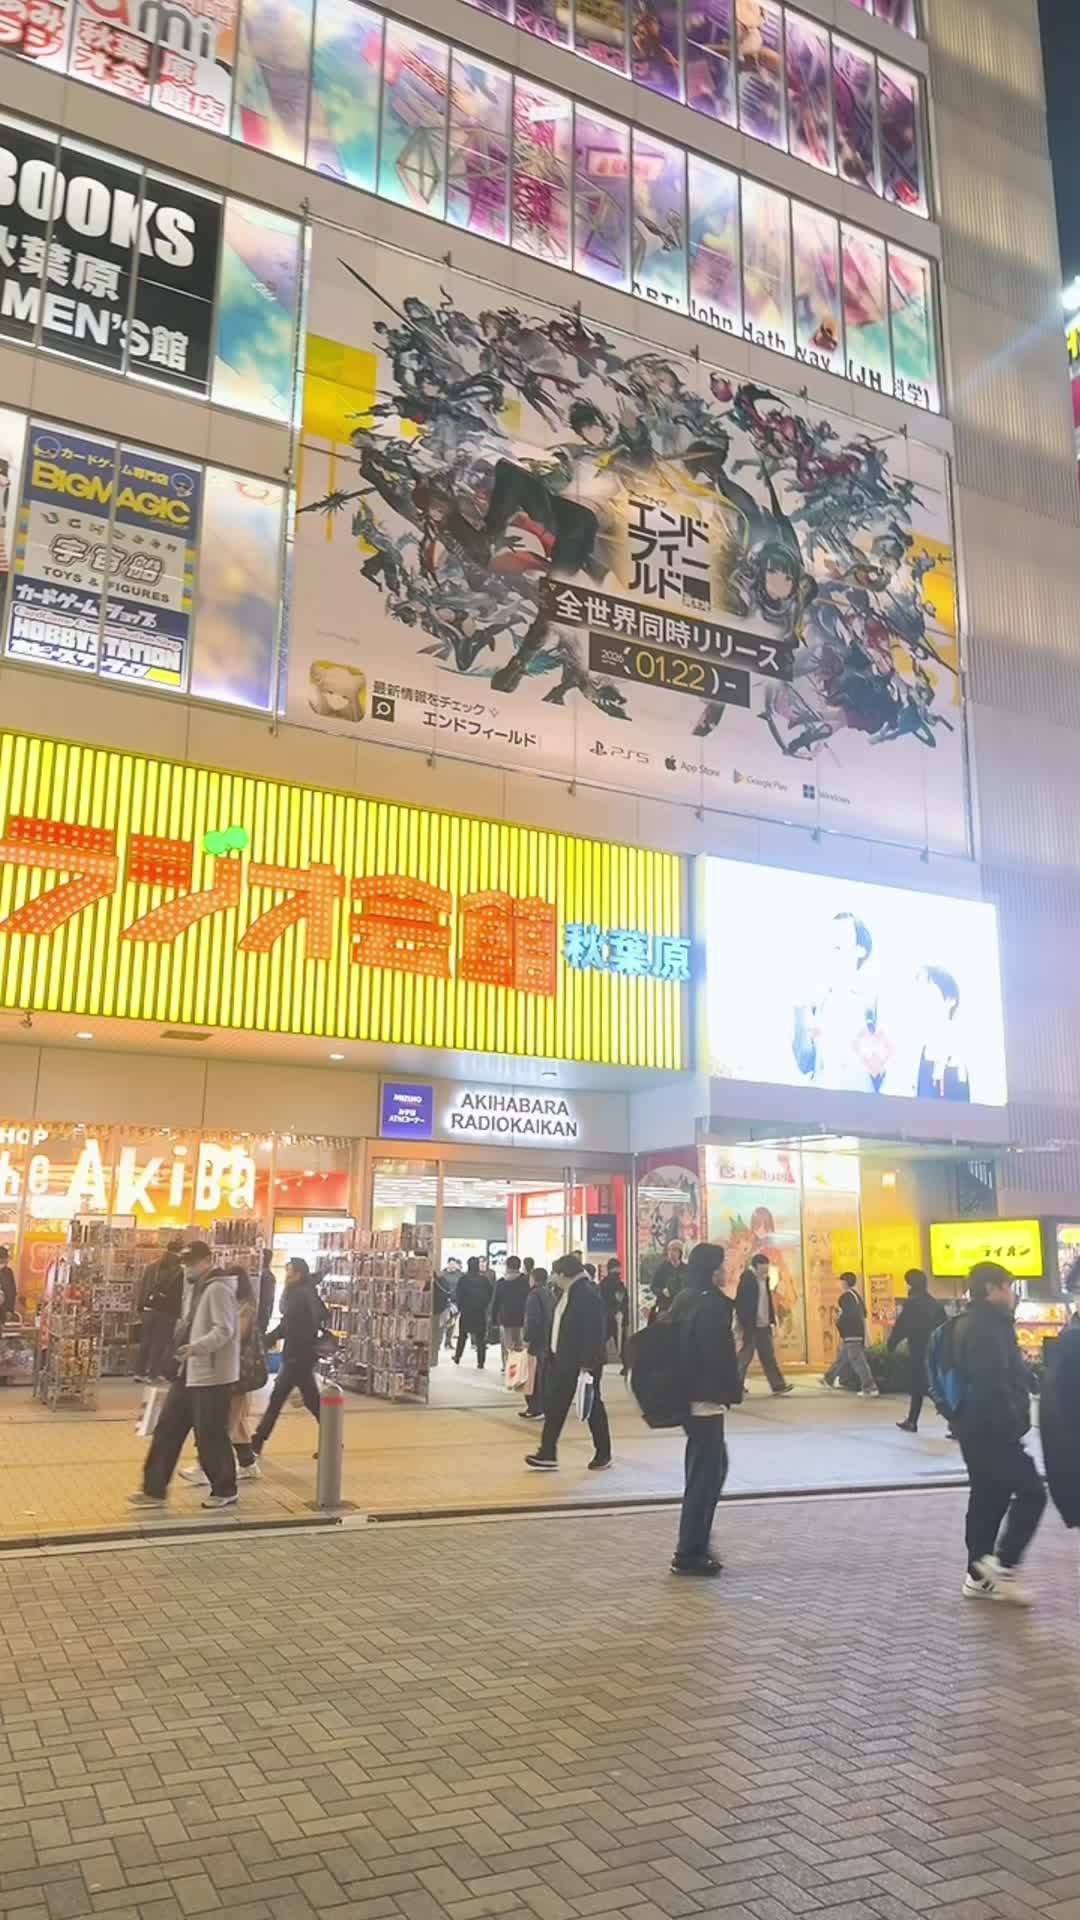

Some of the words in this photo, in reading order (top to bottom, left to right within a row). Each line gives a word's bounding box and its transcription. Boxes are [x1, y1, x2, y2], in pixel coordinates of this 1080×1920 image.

[628, 499, 710, 548] エンド
[41, 566, 82, 584] TOYS
[88, 576, 99, 587] &
[108, 581, 170, 604] FIGURES
[628, 560, 682, 600] ルド
[556, 589, 779, 672] 全世界同時リリース
[372, 680, 486, 716] 最新情報をチェック
[423, 711, 537, 748] エンドフィールド
[0, 813, 557, 998] ラジオ会館
[563, 921, 693, 982] 秋葉原
[460, 1093, 570, 1117] AKIHABARA
[450, 1113, 578, 1138] RADIOKAIKAN
